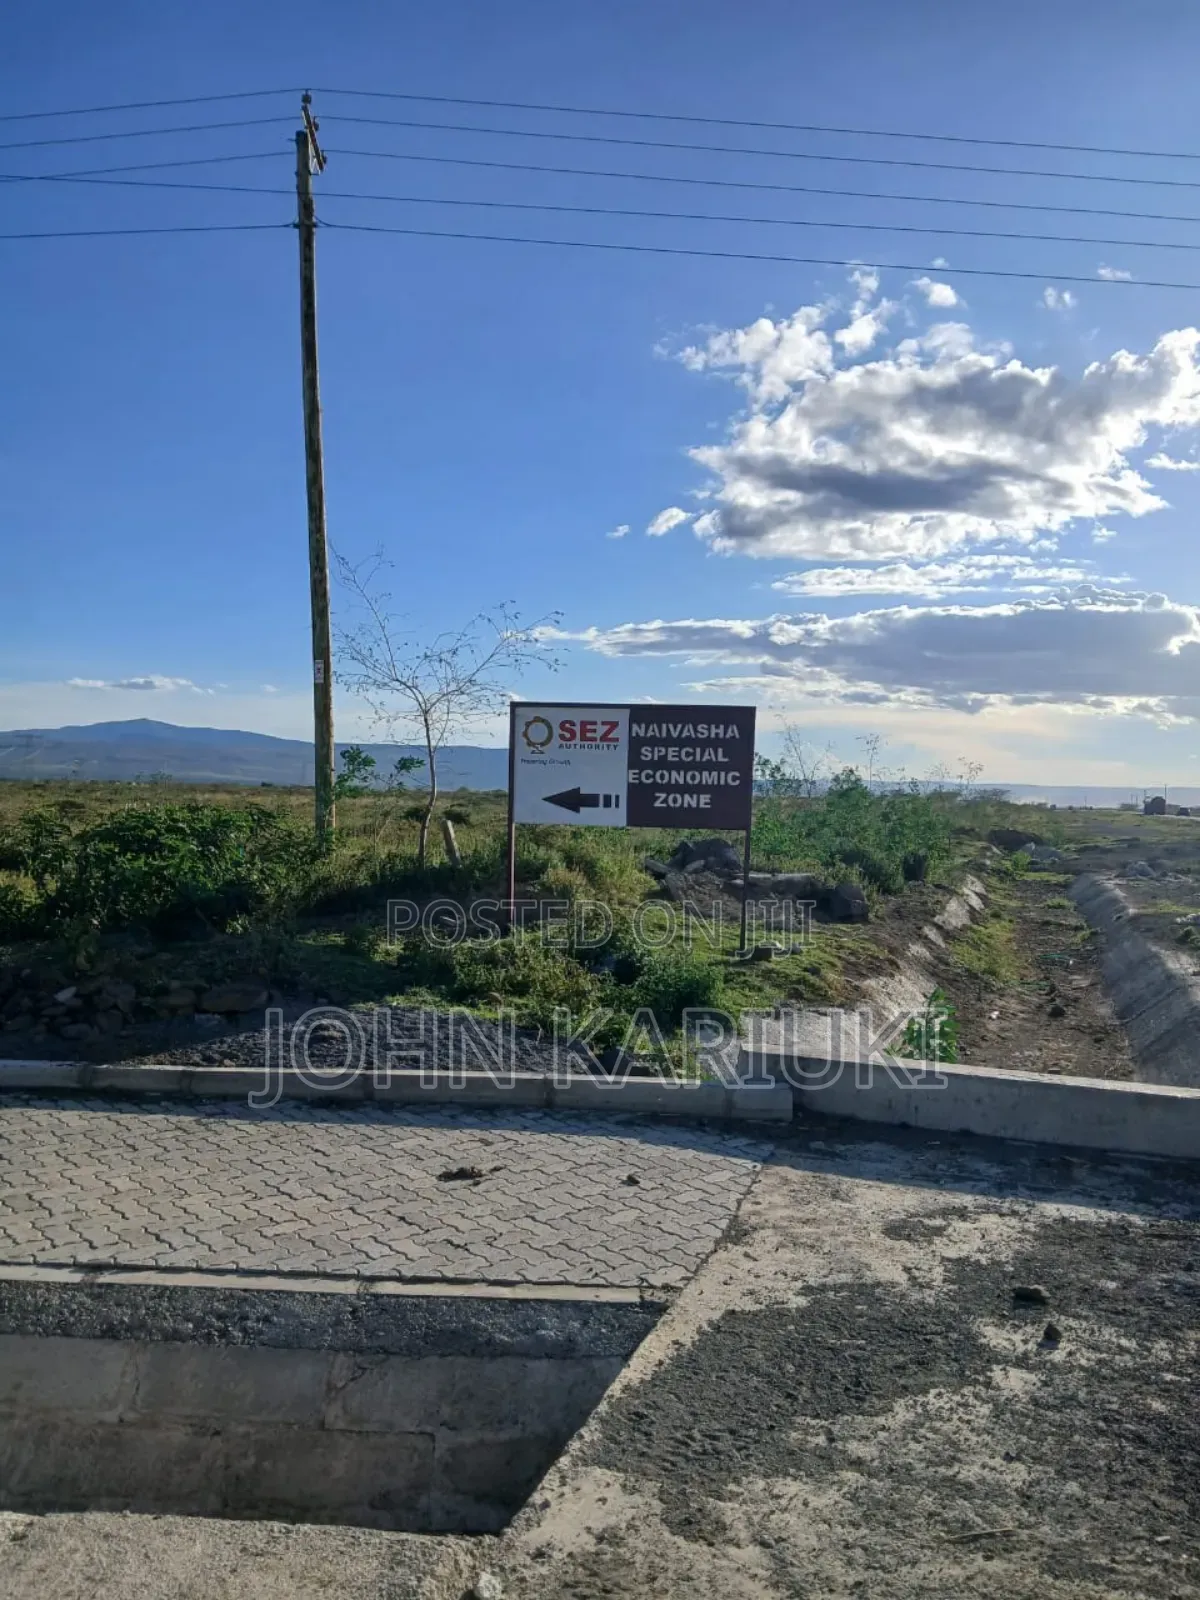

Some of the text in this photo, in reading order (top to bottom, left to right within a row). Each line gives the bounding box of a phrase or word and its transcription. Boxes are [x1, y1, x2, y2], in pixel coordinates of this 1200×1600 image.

[558, 719, 620, 743] SEZ
[631, 723, 740, 739] NAIVASHA
[558, 743, 620, 751] AUTHORITY
[640, 746, 729, 762] SPECIAL
[628, 769, 741, 786] ECONOMIC
[653, 792, 712, 809] ZONE
